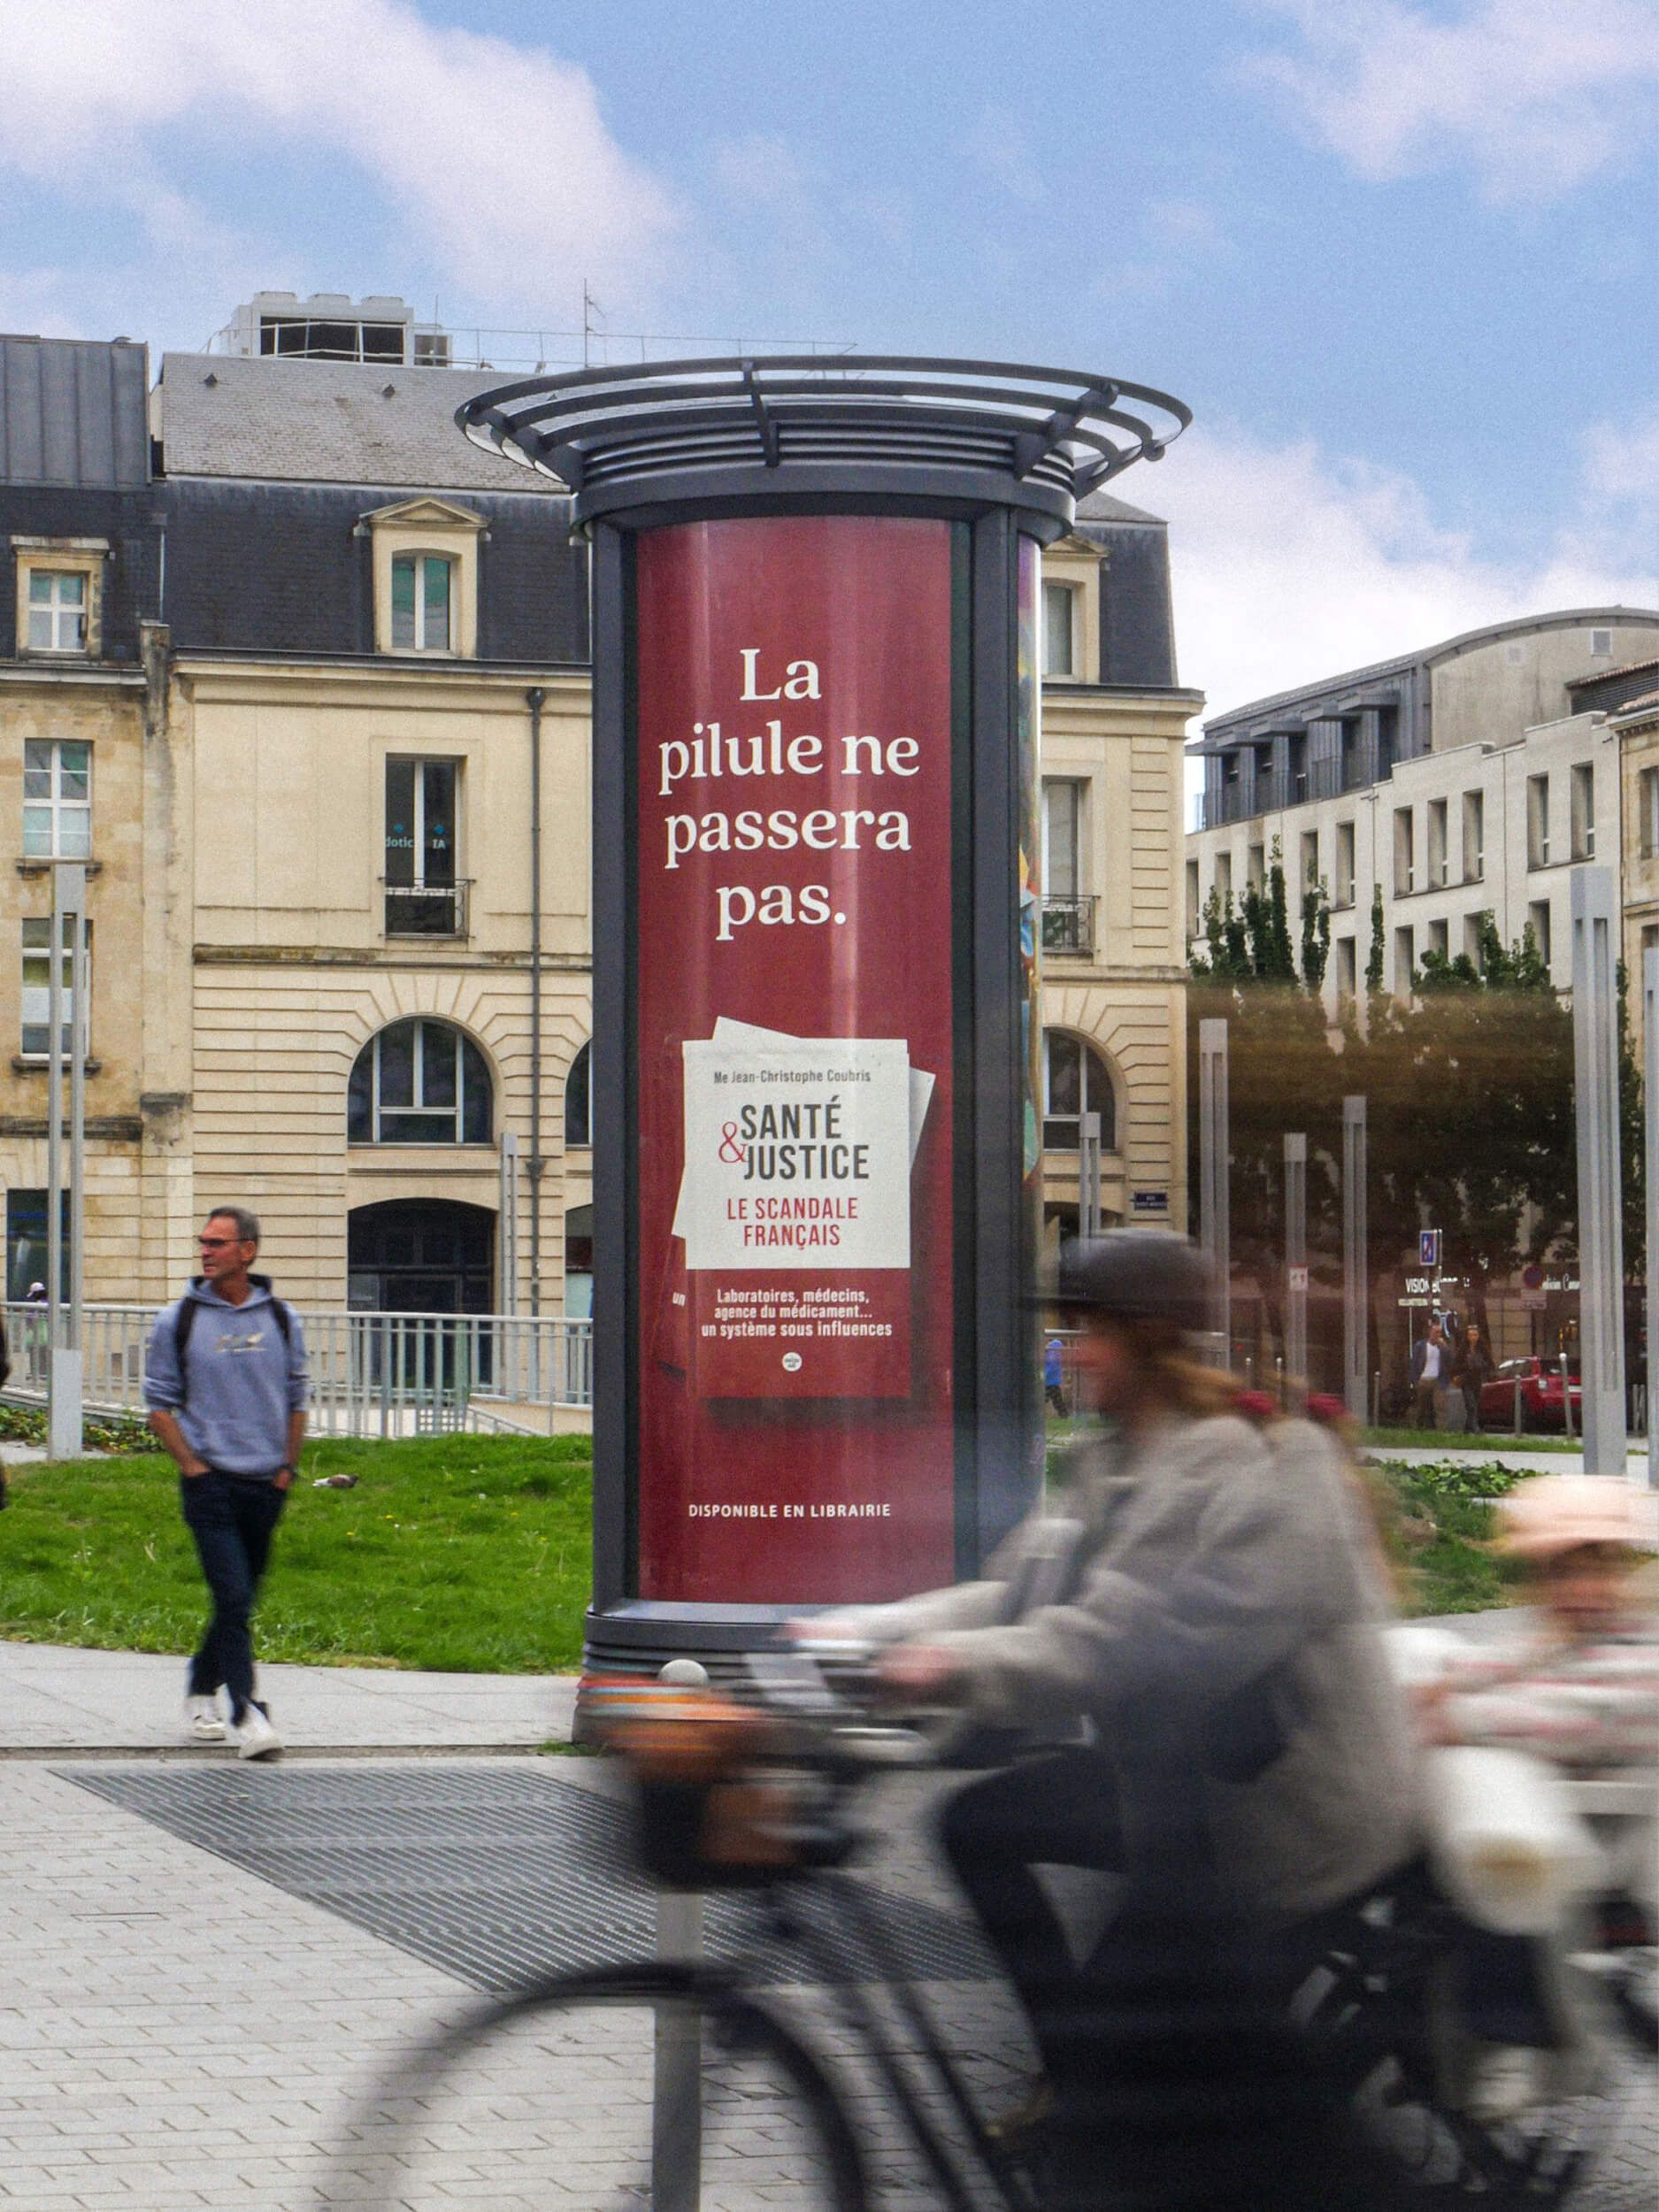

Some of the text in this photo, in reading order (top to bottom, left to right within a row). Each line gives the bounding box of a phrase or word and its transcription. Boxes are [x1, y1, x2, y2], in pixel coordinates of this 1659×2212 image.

[740, 649, 822, 701] La
[658, 719, 919, 795] pilule ne
[664, 810, 912, 869] passera
[716, 885, 847, 941] pas.
[714, 1069, 872, 1085] Me Jean-Christophe Coubris
[741, 1094, 841, 1141] SANTÉ
[718, 1120, 870, 1180] & JUSTICE
[727, 1197, 858, 1220] LE SCANDALE
[743, 1224, 841, 1250] FRANÇAIS
[717, 1287, 869, 1305] Laboratoires, médecins,
[714, 1303, 872, 1322] agence du médicament...
[702, 1320, 893, 1340] un système sous influences
[689, 1502, 891, 1518] DISPONIBLE EN LIBRAIRIE
